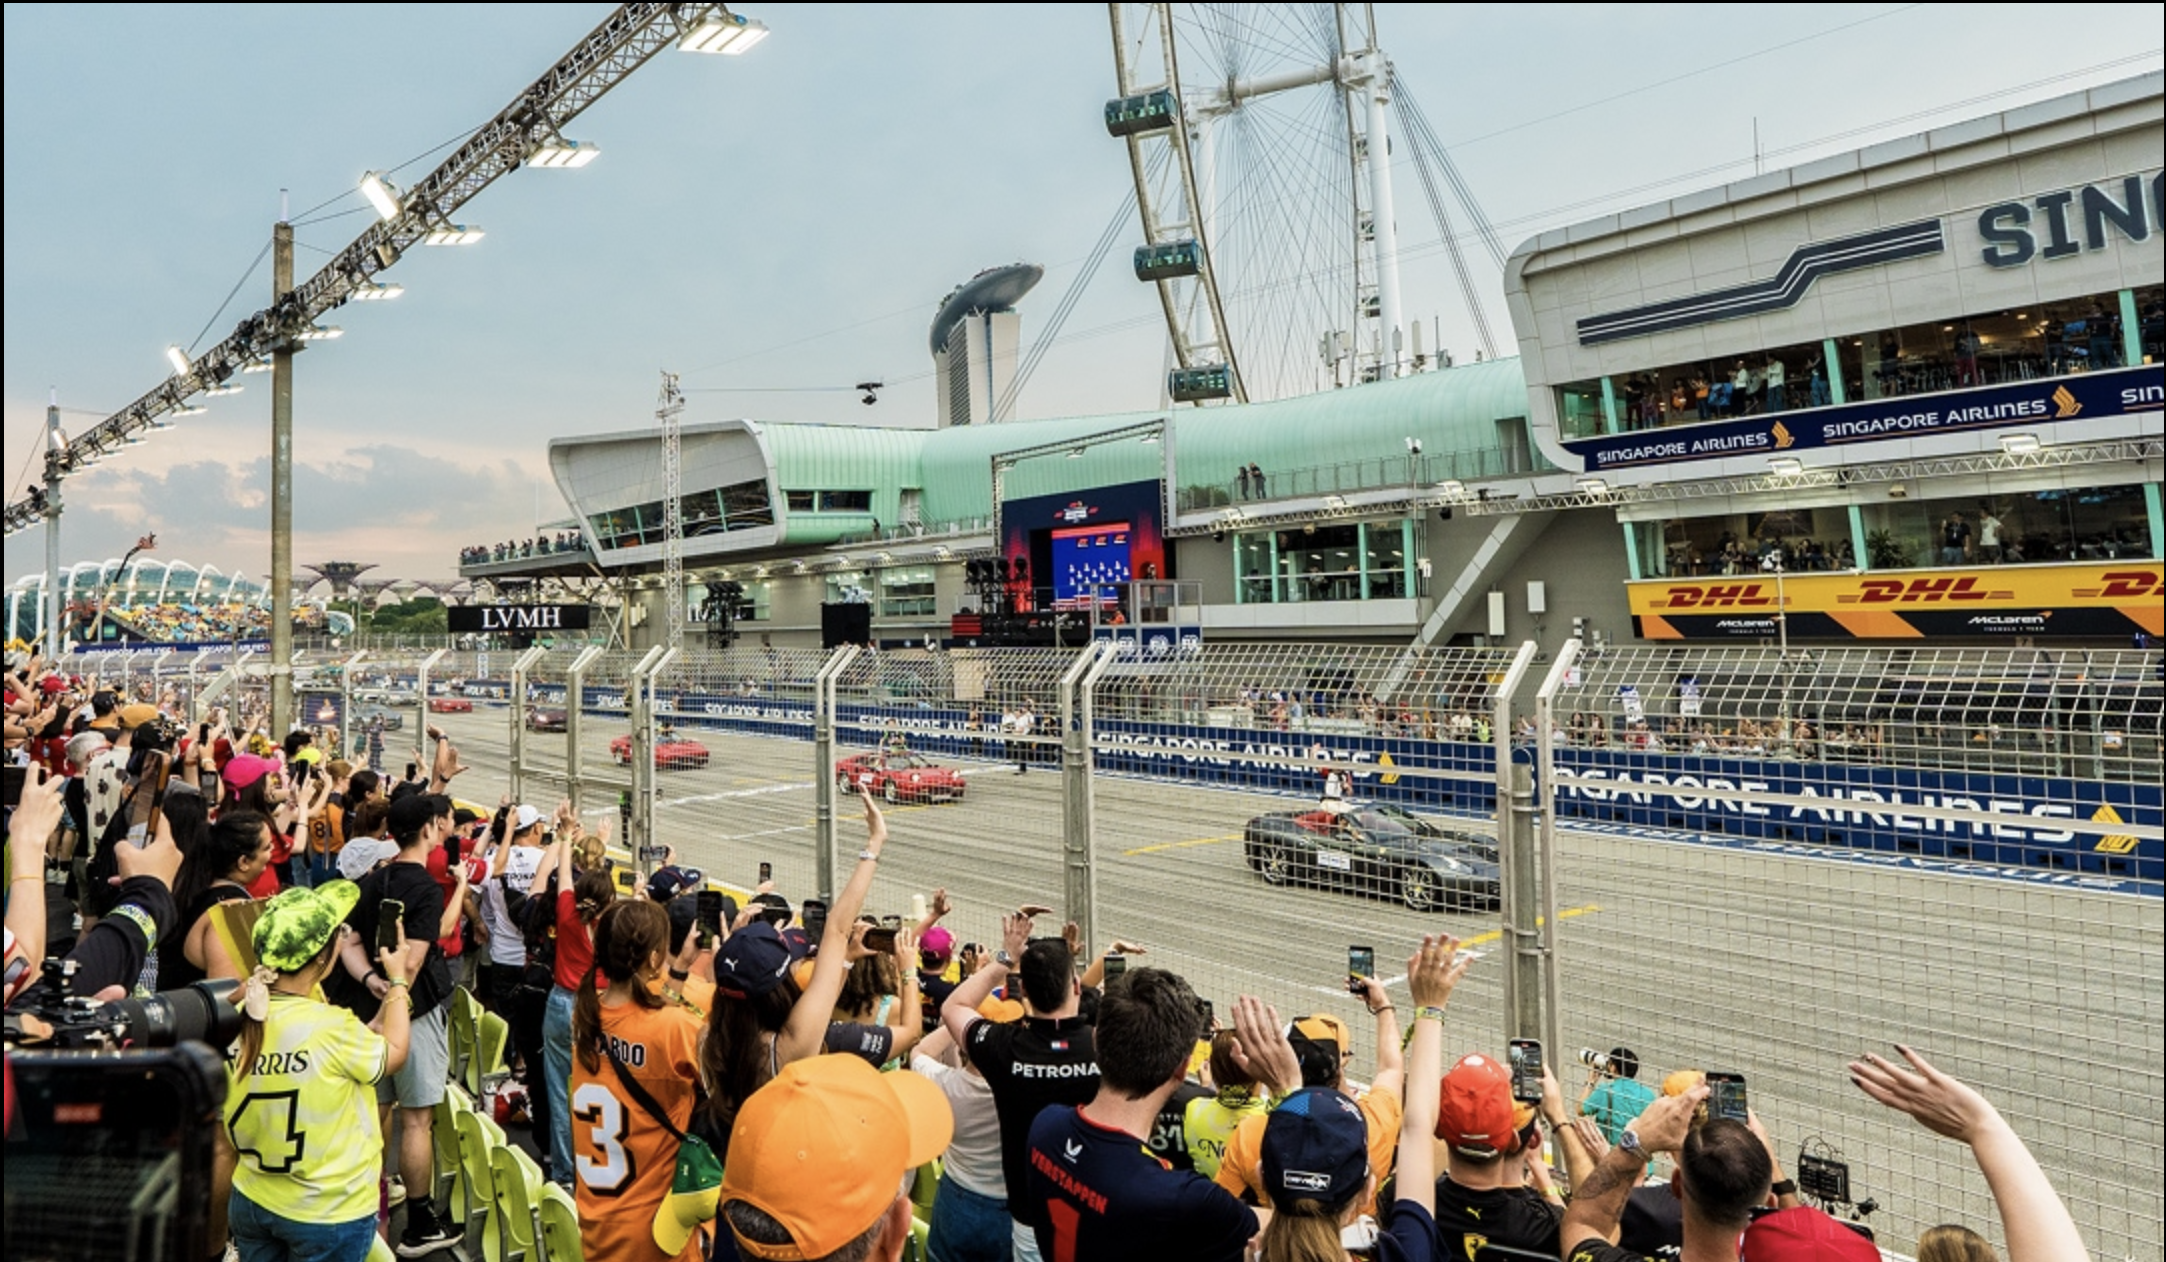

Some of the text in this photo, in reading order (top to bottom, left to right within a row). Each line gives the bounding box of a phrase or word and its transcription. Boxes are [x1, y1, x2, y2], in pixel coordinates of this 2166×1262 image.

[1978, 172, 2164, 268] SIN
[1823, 399, 2047, 438] SINGAPORE AIRLINES
[1597, 432, 1768, 464] SINGAPORE AIRLINES
[1667, 584, 1771, 608] DHL
[1860, 577, 1988, 603] DHL
[2101, 571, 2164, 597] D
[482, 606, 561, 629] LVMH
[1716, 619, 1775, 628] McLaren
[1967, 616, 2045, 625] McLaren
[1097, 734, 1231, 767] SINGAPORE
[1531, 765, 2075, 843] NGAPORE AIRLINES
[228, 1089, 306, 1173] 4
[573, 1083, 637, 1198] 3
[1031, 1146, 1108, 1215] VERSTAPPEN
